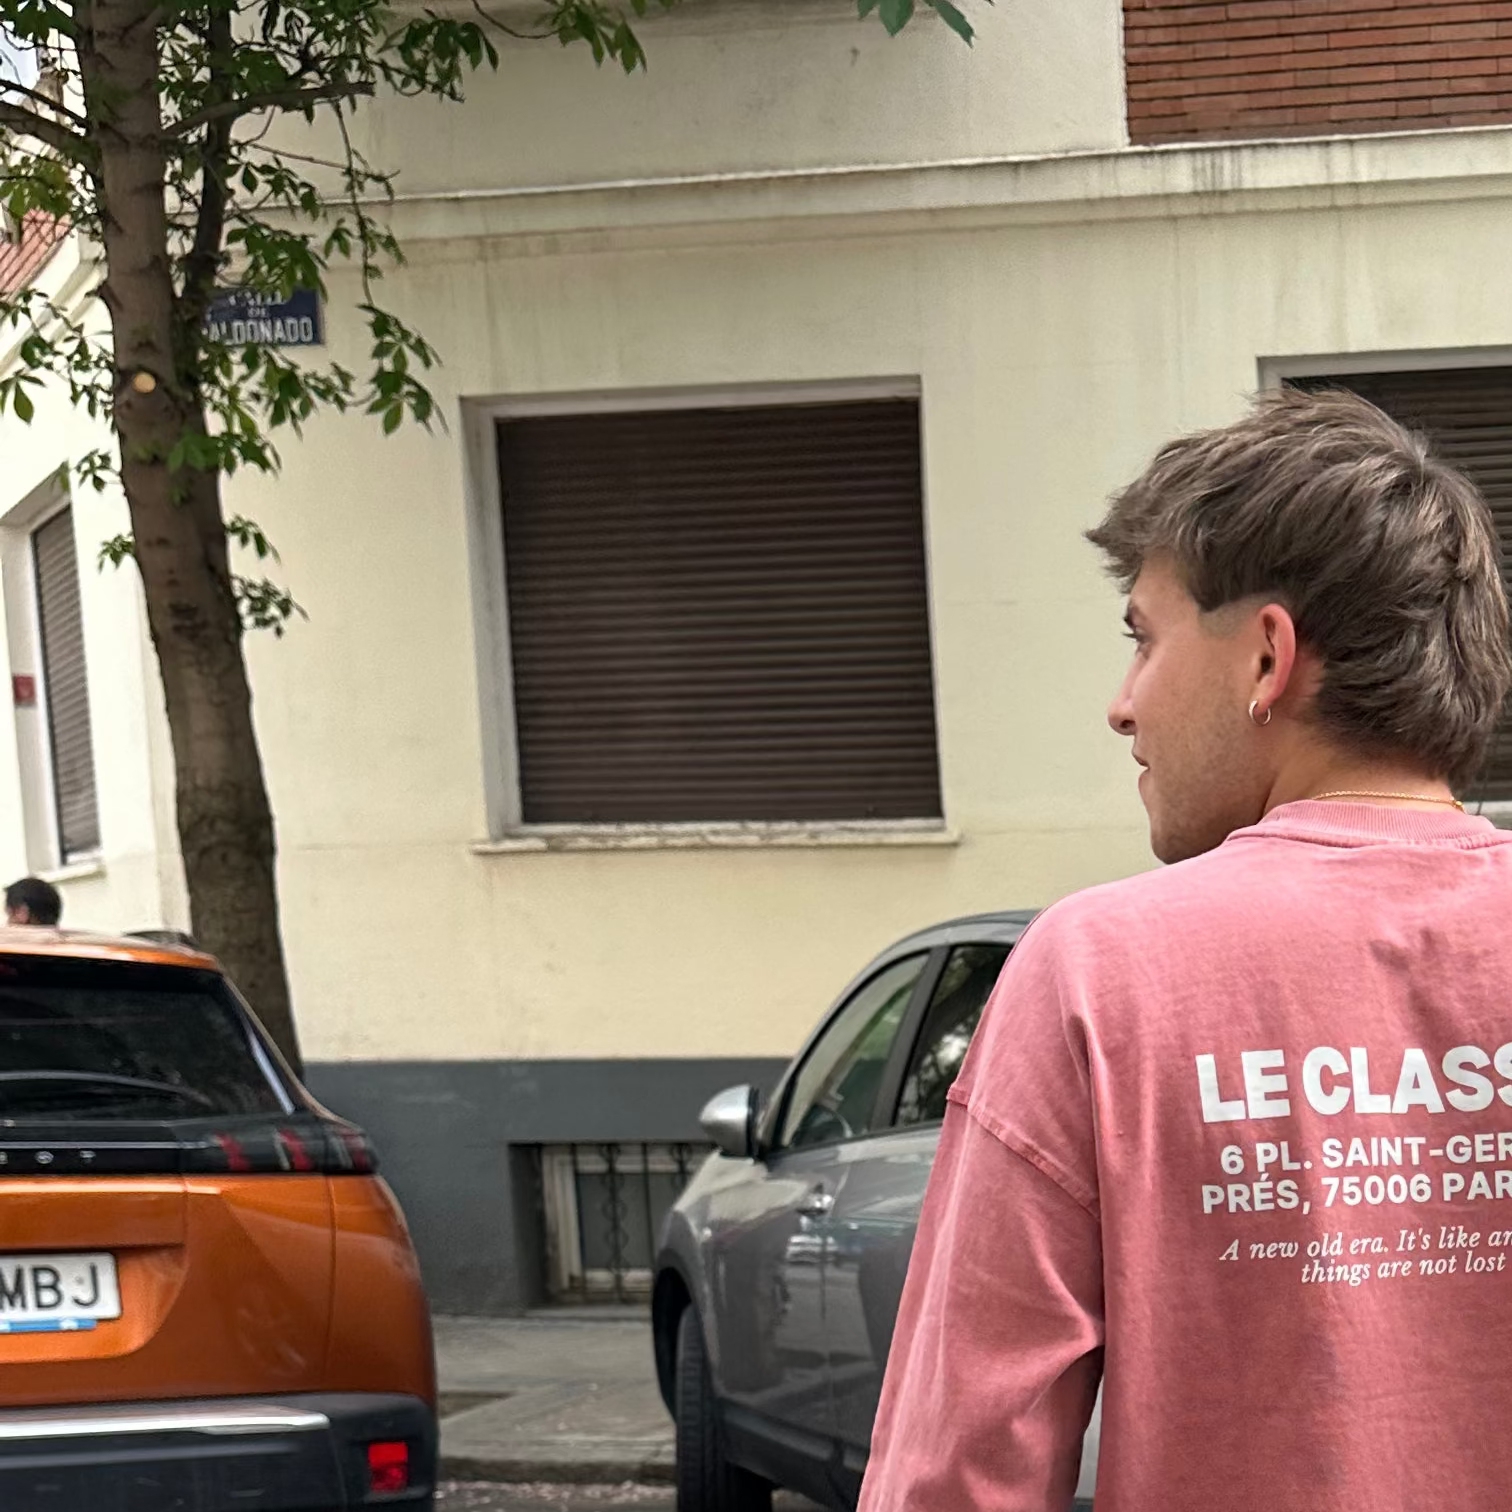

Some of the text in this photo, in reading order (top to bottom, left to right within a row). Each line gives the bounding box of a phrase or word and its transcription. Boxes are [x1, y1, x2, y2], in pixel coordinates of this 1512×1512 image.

[201, 317, 314, 345] ALDONADO
[1195, 1049, 1291, 1124] LE
[1220, 1144, 1245, 1175] 6
[1255, 1140, 1313, 1173] PL.
[1202, 1173, 1311, 1215] PRÉS,
[1321, 1173, 1432, 1206] 75006
[1218, 1238, 1240, 1261] A
[1250, 1241, 1299, 1260] new
[1306, 1232, 1344, 1258] old
[1350, 1236, 1389, 1255] era.
[1396, 1229, 1431, 1252] It's
[1439, 1226, 1481, 1249] like
[0, 1263, 100, 1311] MBJ
[1301, 1258, 1371, 1287] things
[1378, 1260, 1412, 1279] are
[1419, 1255, 1457, 1276] not
[1465, 1250, 1506, 1273] lost
